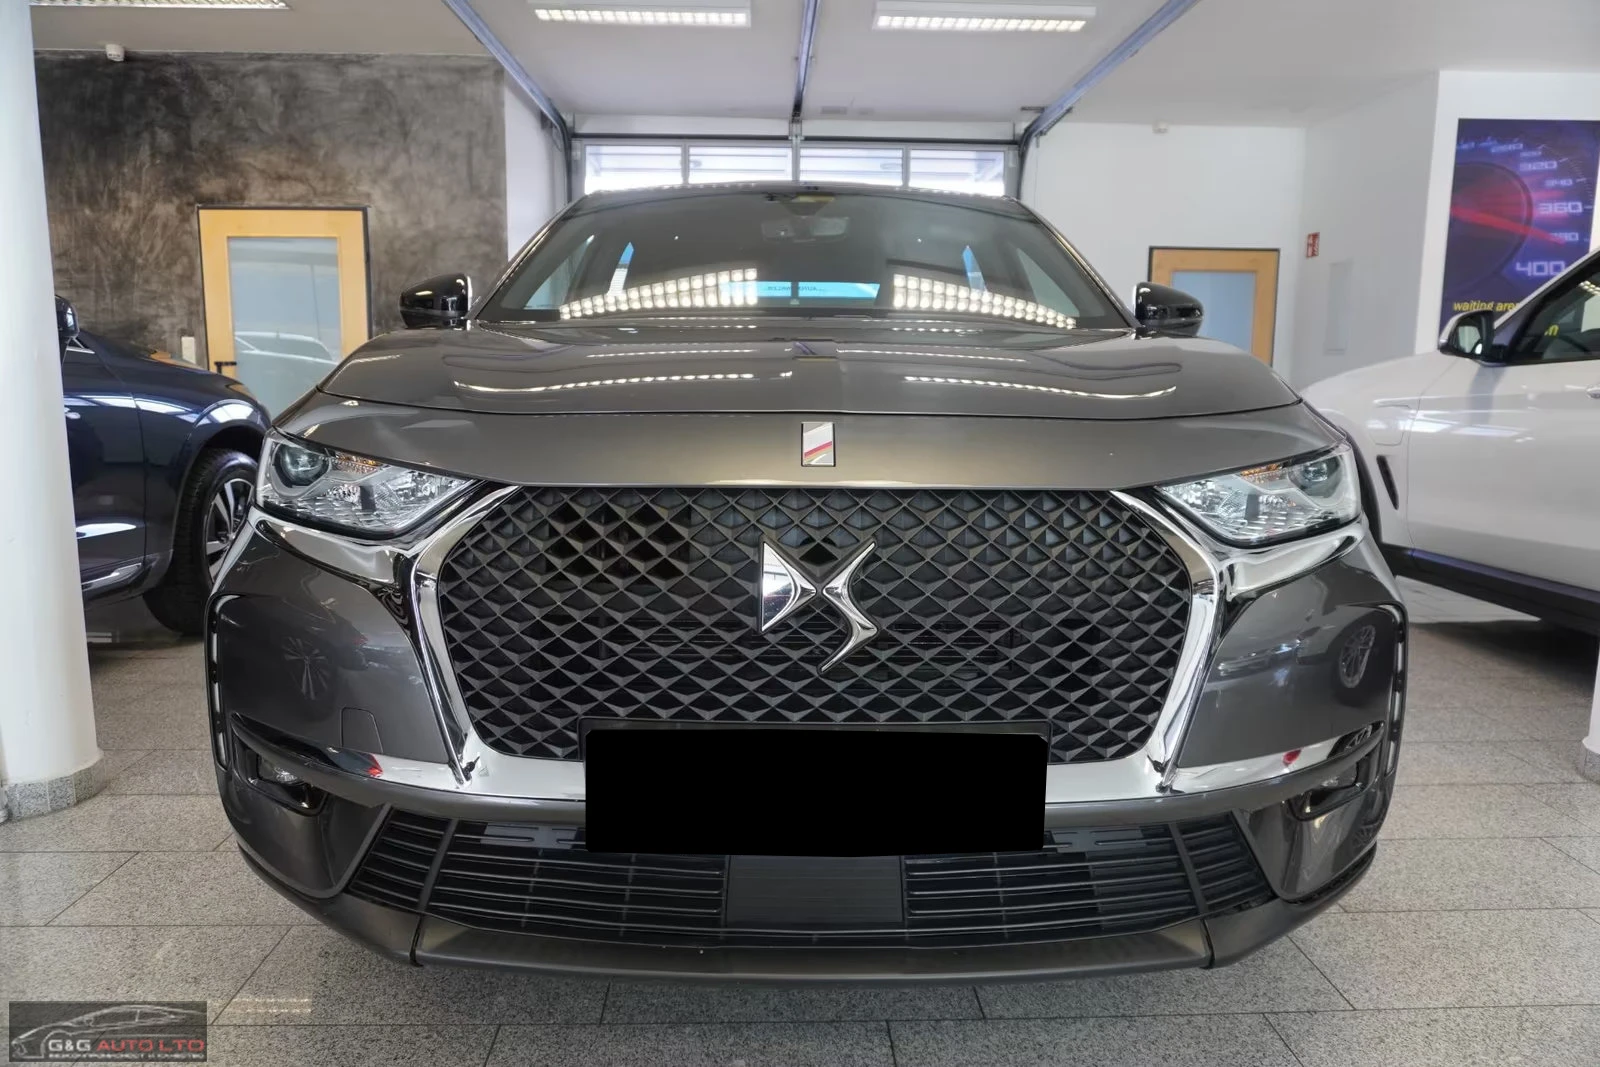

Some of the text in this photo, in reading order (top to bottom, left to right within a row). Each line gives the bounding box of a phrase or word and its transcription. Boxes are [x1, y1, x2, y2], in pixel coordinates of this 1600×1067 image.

[1539, 202, 1583, 213] 360
[1516, 261, 1565, 276] 400
[1453, 300, 1520, 312] waiting are
